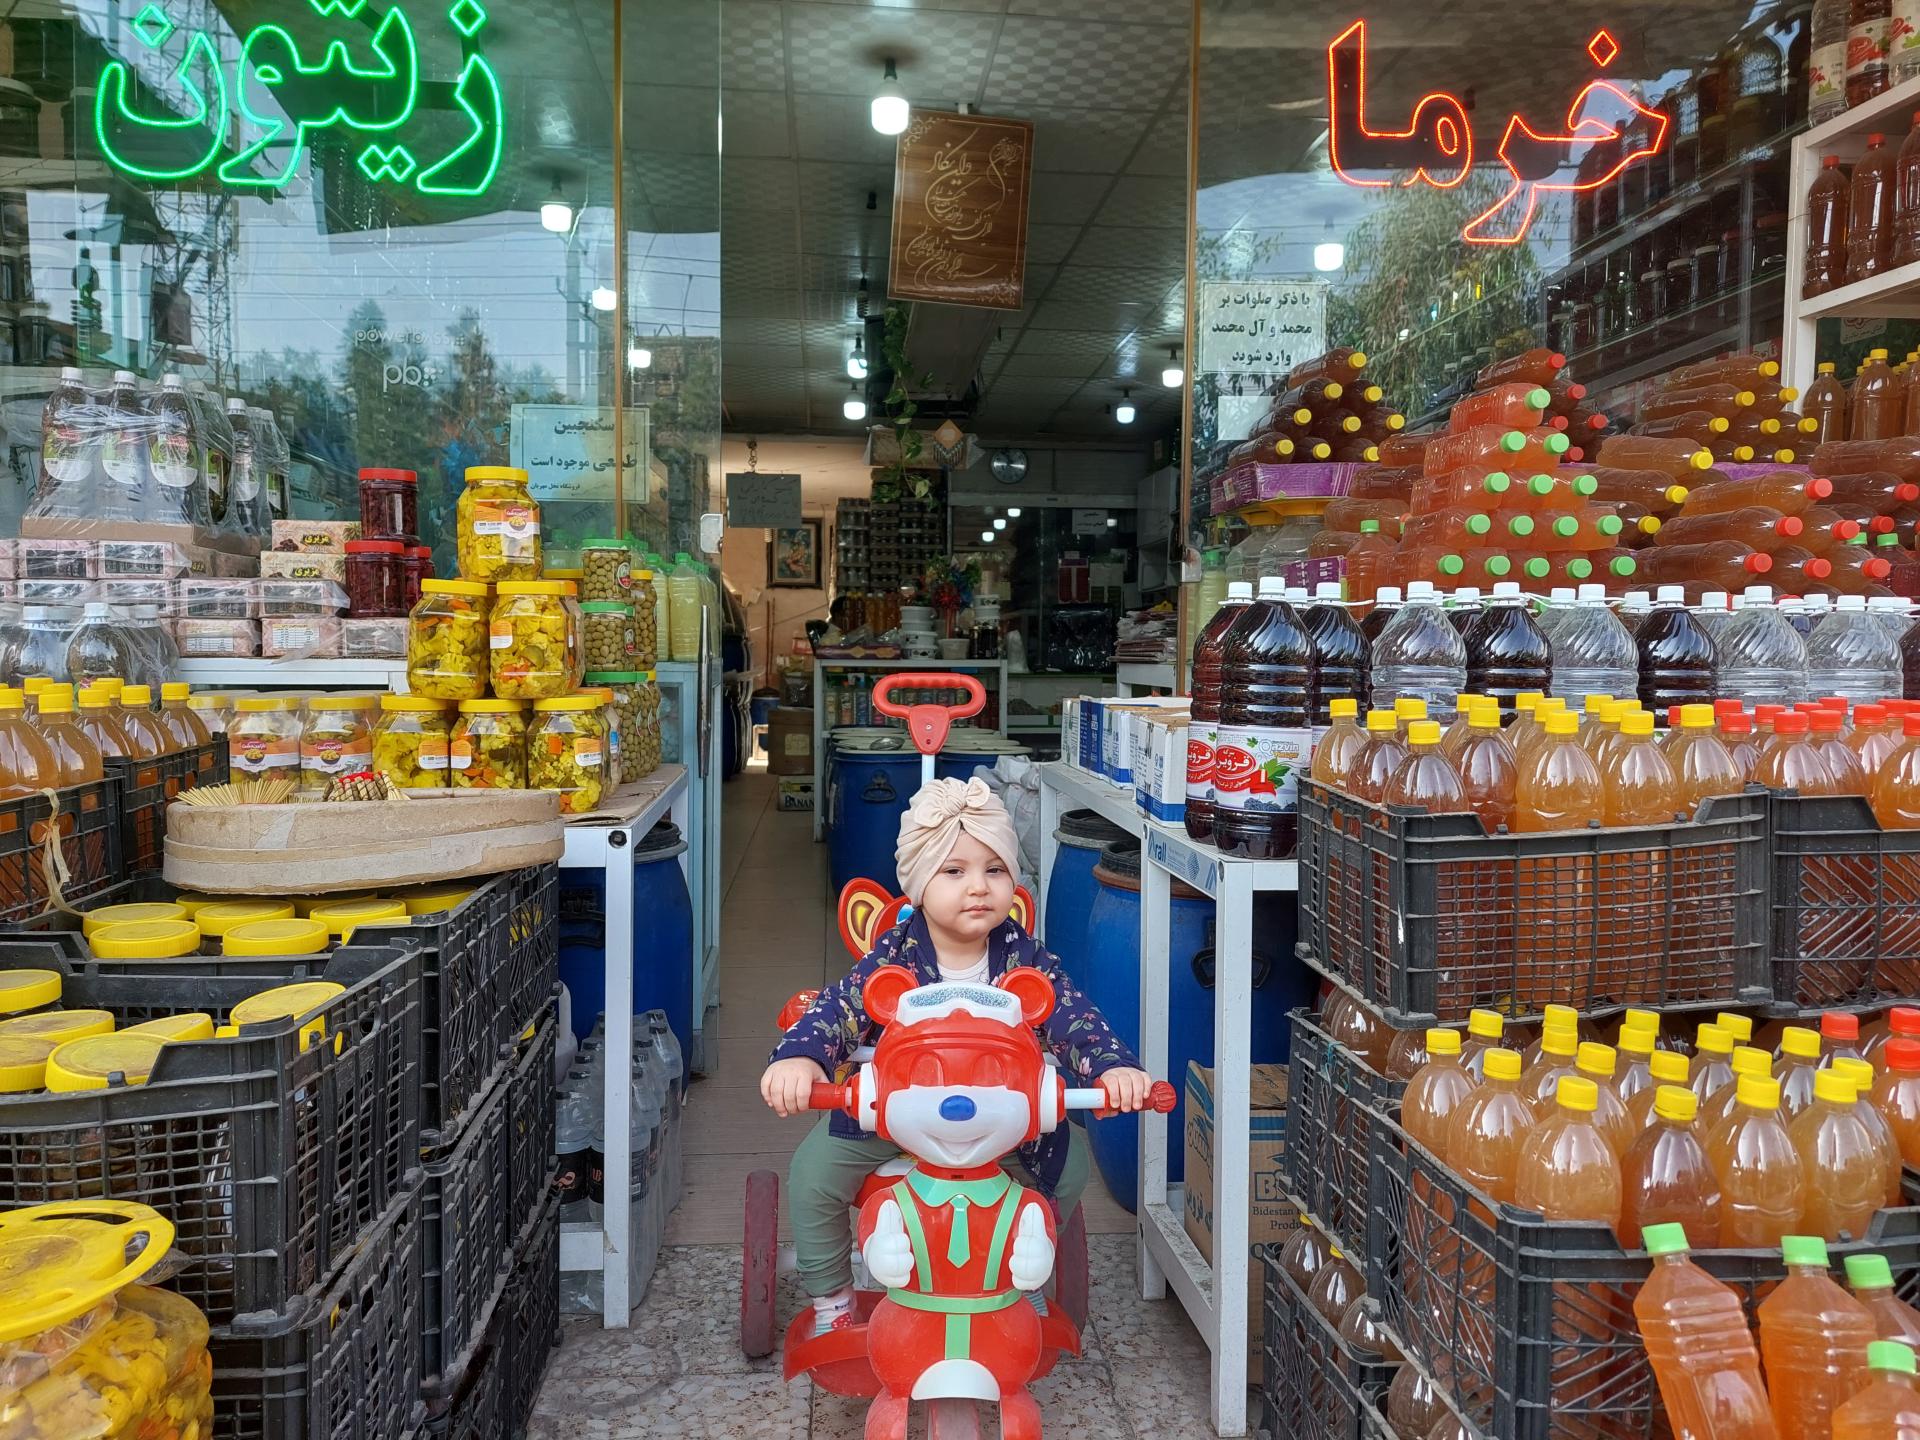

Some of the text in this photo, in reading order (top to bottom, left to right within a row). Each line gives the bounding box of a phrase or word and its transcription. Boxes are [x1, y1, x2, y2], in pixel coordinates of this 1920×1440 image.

[96, 0, 503, 195] زیتون
[1329, 18, 1669, 244] خرما
[1218, 291, 1310, 309] با ذکر صلوات بر
[1211, 319, 1312, 337] محمد و آل محمد
[1232, 348, 1291, 366] وارد شوید
[530, 453, 638, 472] طبعی موجود است
[1259, 739, 1300, 758] Qazvin
[784, 794, 815, 809] BANAN
[1252, 1206, 1294, 1216] Bidestan
[1270, 1219, 1303, 1230] Produ
